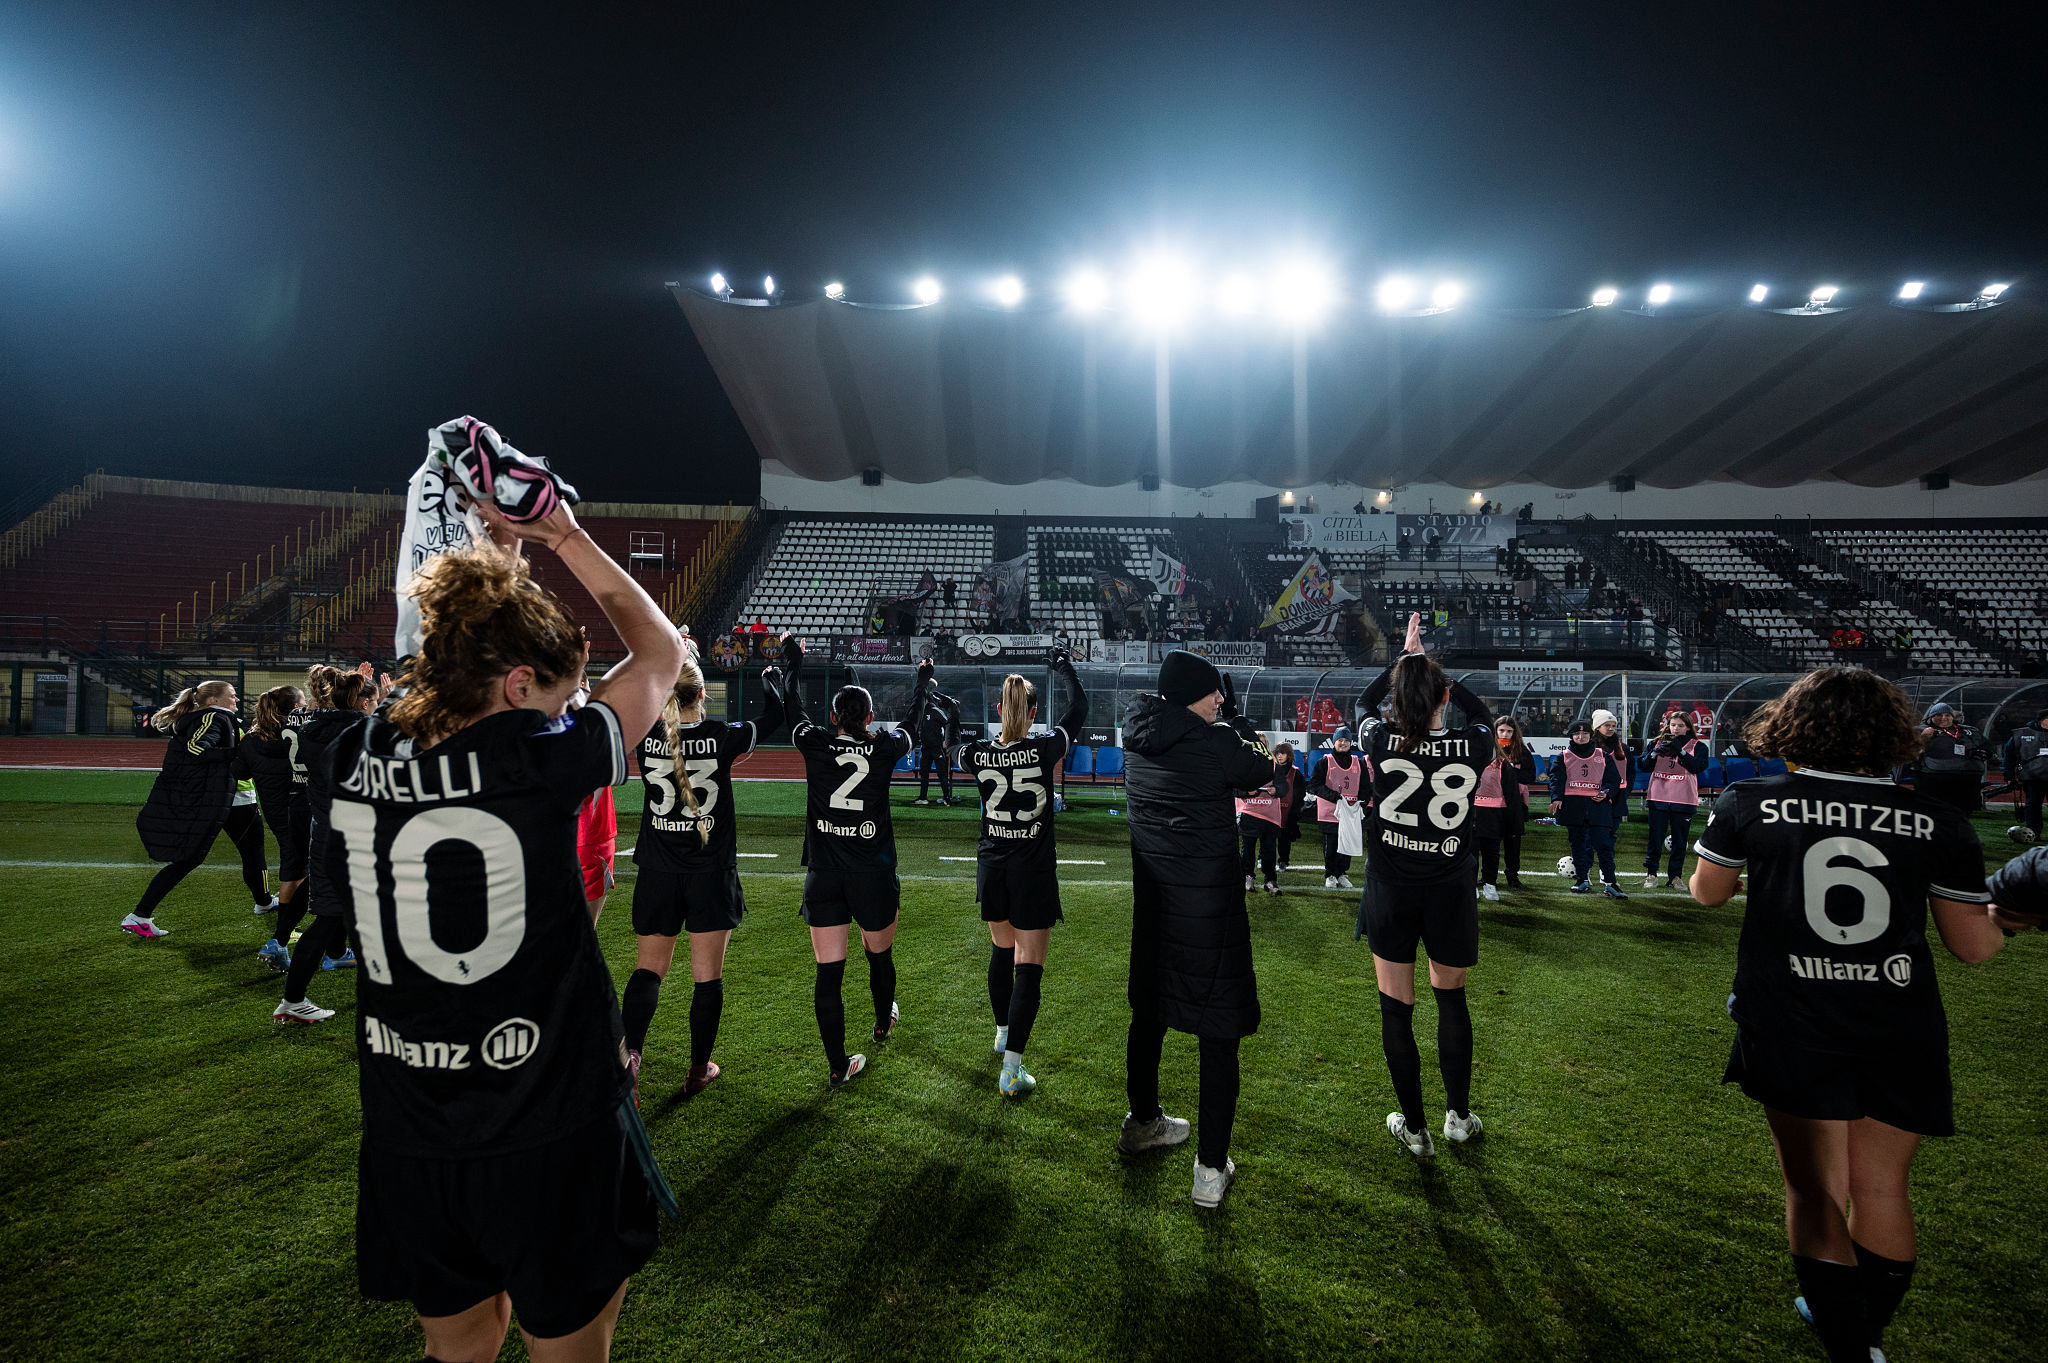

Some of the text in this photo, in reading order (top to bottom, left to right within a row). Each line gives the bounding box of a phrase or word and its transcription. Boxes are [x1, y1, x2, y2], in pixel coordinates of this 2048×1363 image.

[1322, 515, 1363, 528] CITTÀ
[1417, 515, 1492, 526] STADIO
[1323, 531, 1389, 542] di BIELLA
[1279, 598, 1331, 620] DOMINIO
[846, 653, 858, 661] all
[881, 654, 904, 662] Heart
[1206, 643, 1251, 655] DOMINIO
[960, 728, 977, 738] Jeep
[1090, 733, 1107, 742] Jeep
[1549, 743, 1567, 752] Jeep
[974, 748, 1040, 768] CALLIGARIS
[829, 752, 870, 811] 2
[1569, 781, 1600, 789] BALOCCO
[1654, 772, 1685, 780] BALOCCO
[644, 756, 719, 818] 33
[977, 766, 1047, 822] 25
[1379, 758, 1478, 830] 28
[651, 815, 694, 832] Allianz
[816, 819, 857, 837] Allianz
[1760, 798, 1935, 841] SCHATZER
[988, 824, 1028, 839] Allianz
[1382, 829, 1439, 853] Allianz
[330, 798, 526, 985] 10
[1803, 836, 1891, 945] 6
[1788, 953, 1879, 982] Allianz
[365, 1015, 471, 1071] Allianz
